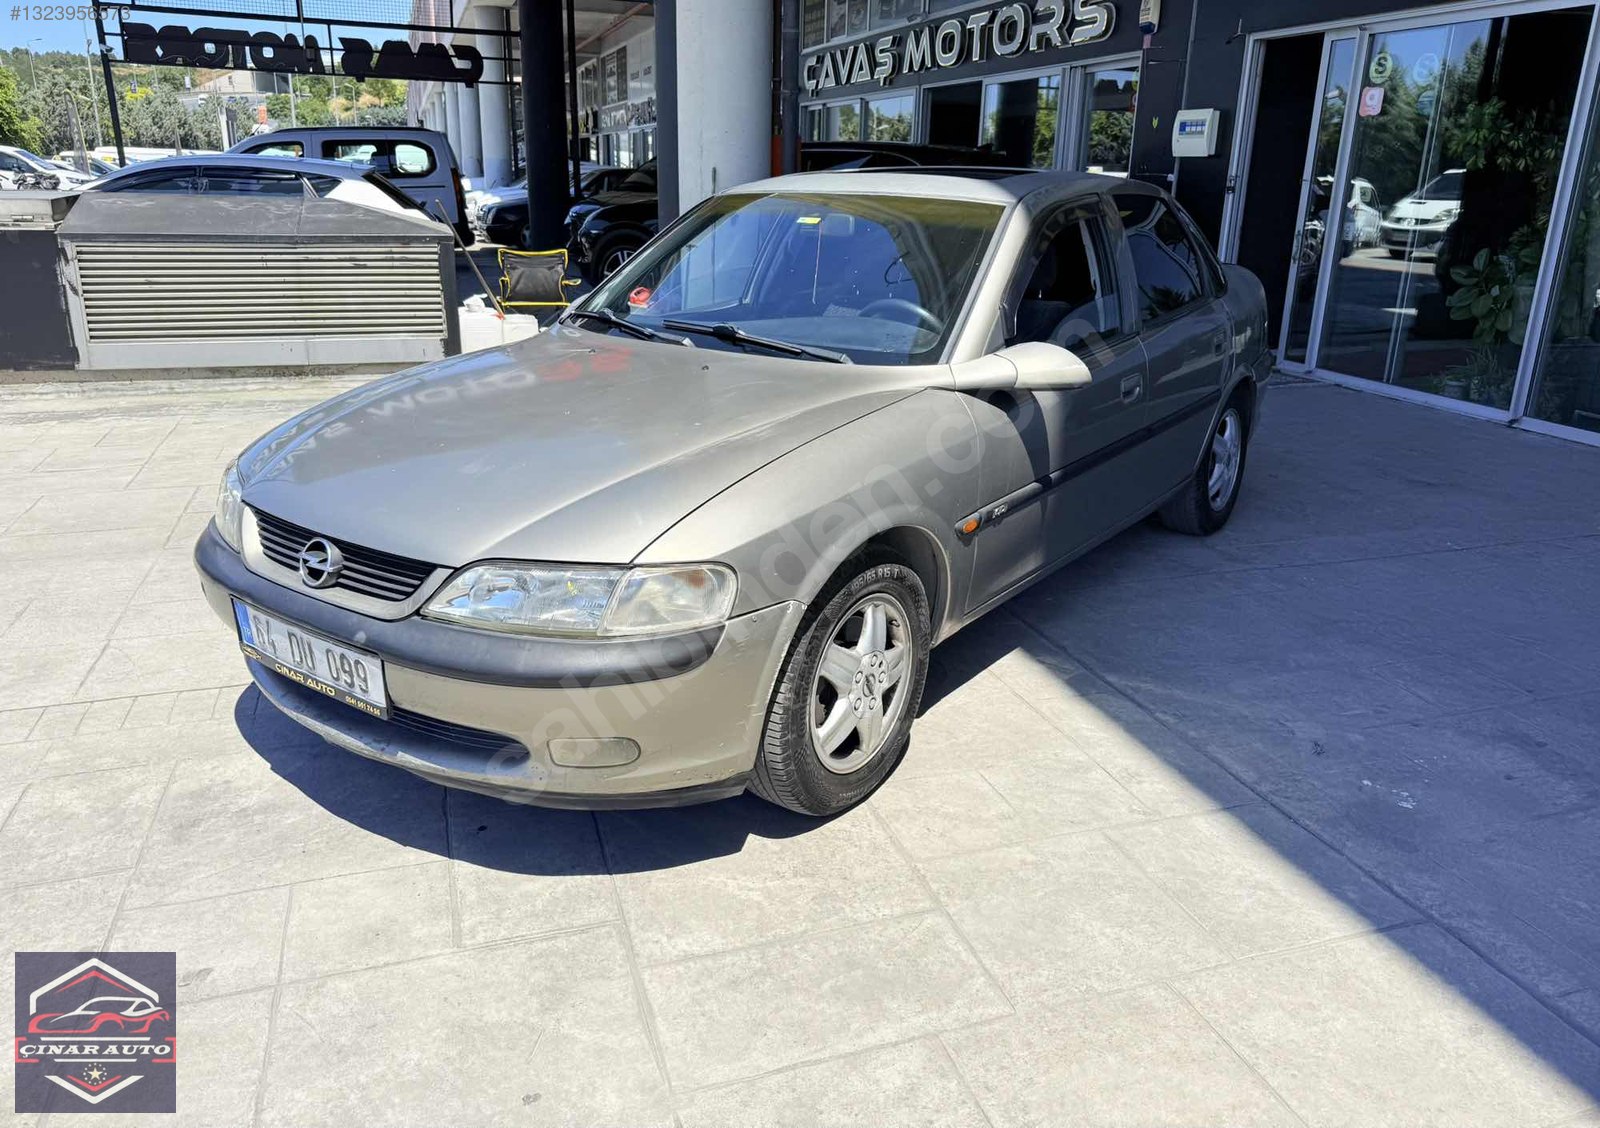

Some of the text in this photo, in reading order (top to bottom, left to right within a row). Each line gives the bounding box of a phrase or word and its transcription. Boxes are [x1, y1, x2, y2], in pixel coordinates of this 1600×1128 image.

[803, 0, 1115, 97] ÇAVAŞ MOTORS
[253, 614, 277, 656] 64
[325, 647, 370, 694] 099
[307, 678, 336, 696] AUTO
